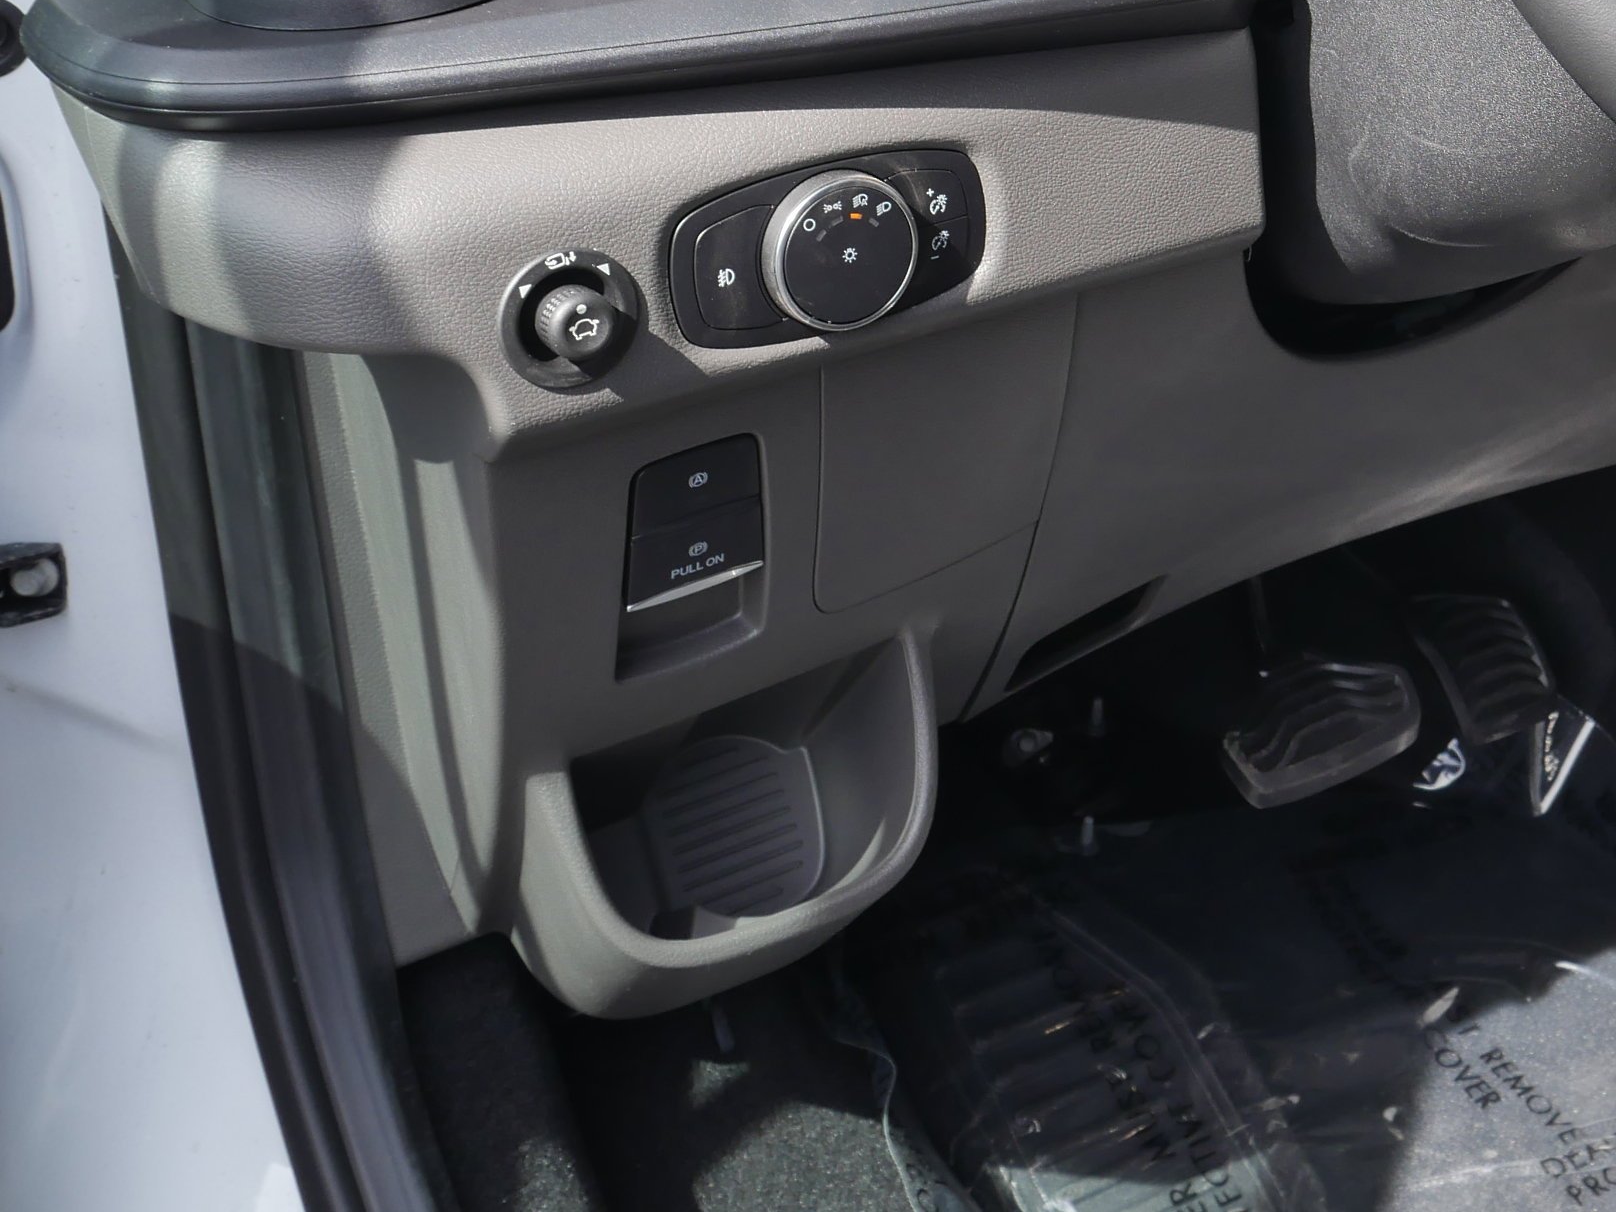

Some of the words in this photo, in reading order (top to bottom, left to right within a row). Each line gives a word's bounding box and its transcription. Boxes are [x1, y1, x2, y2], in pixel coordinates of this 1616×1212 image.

[671, 562, 704, 579] PULL
[706, 552, 725, 567] ON
[1424, 1027, 1502, 1111] COVER
[1480, 1046, 1584, 1146] REMOVE
